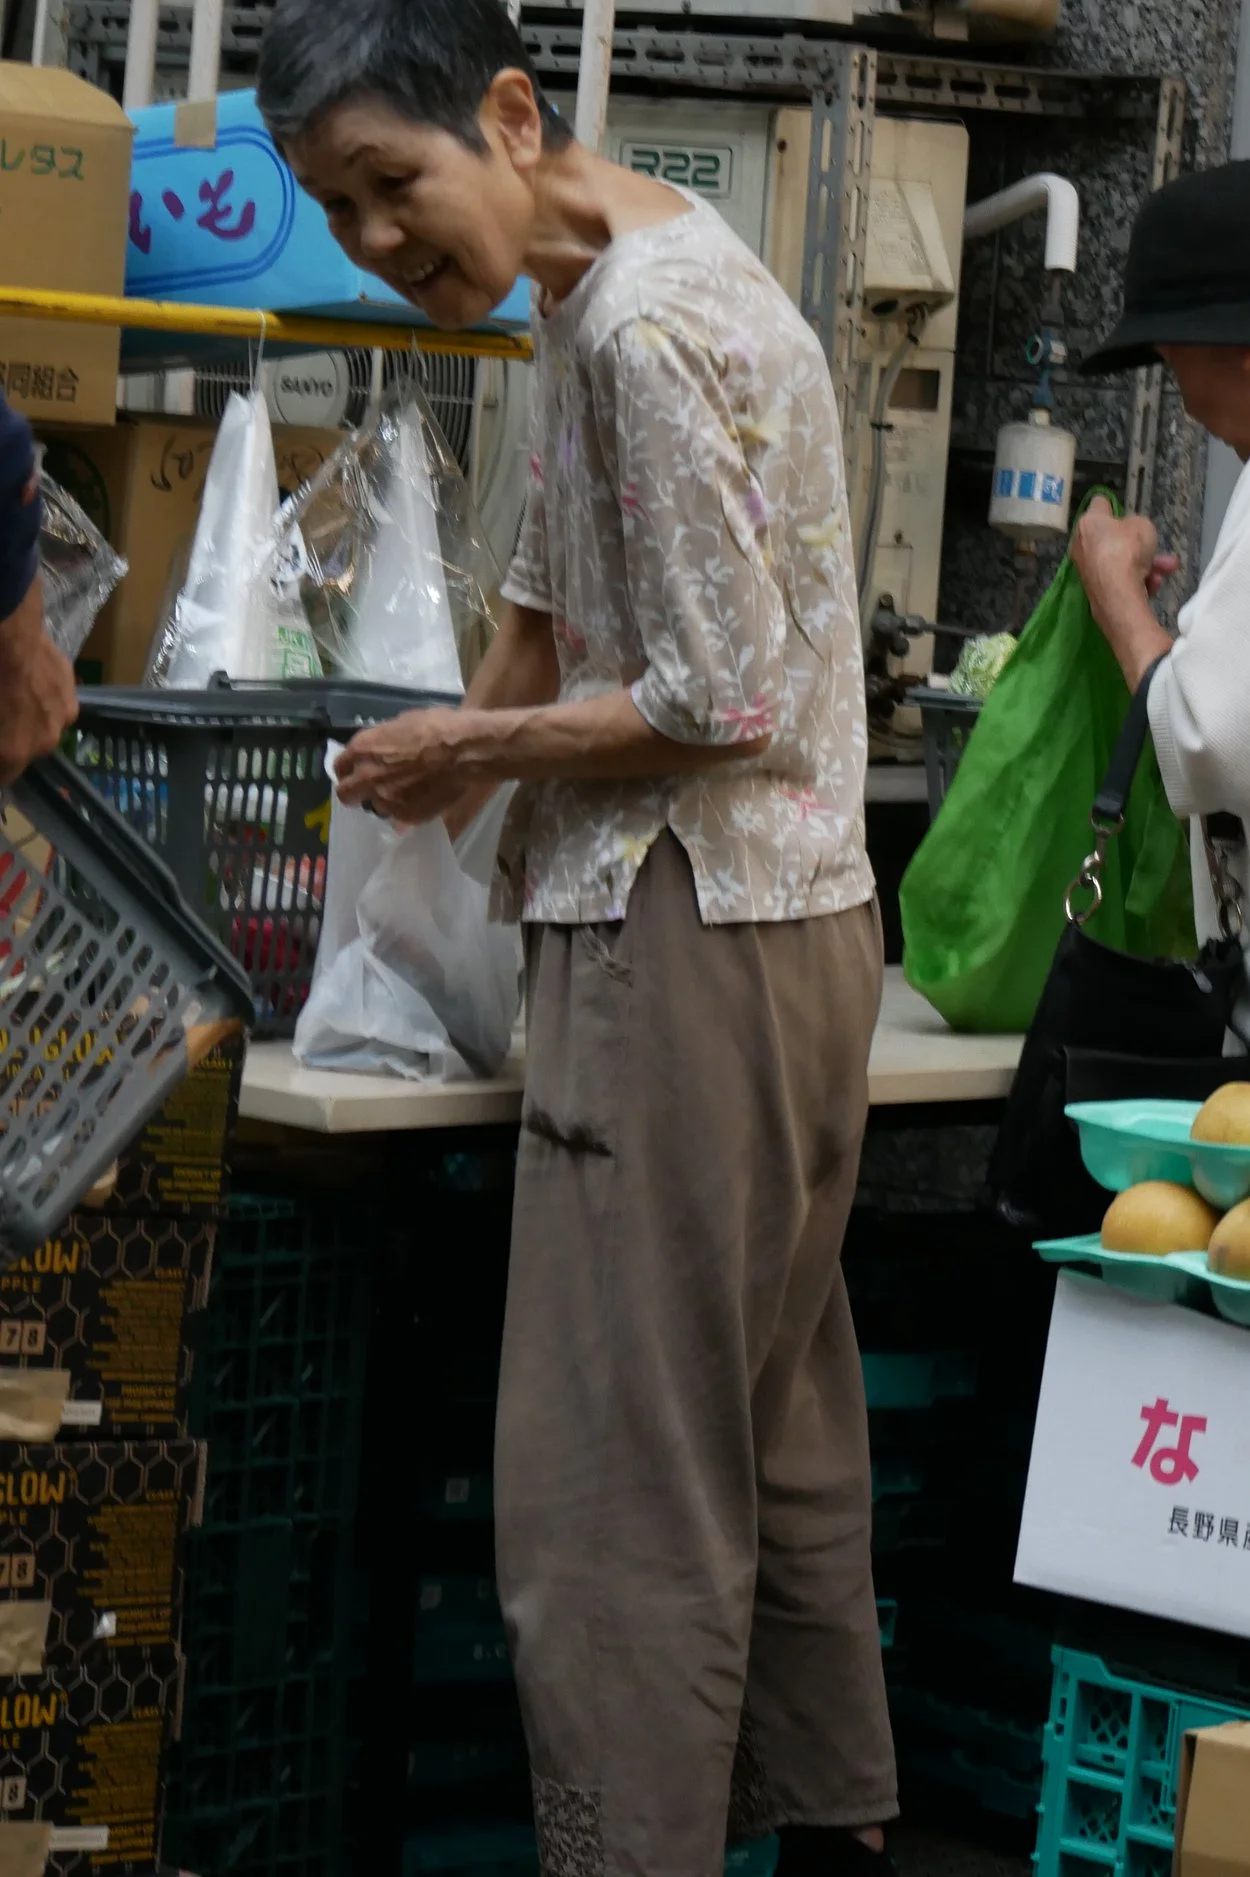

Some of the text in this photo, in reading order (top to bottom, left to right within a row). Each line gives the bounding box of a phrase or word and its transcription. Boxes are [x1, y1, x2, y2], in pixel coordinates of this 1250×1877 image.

[631, 149, 720, 189] R22
[0, 363, 79, 404] 同組合
[281, 375, 333, 398] SANYO
